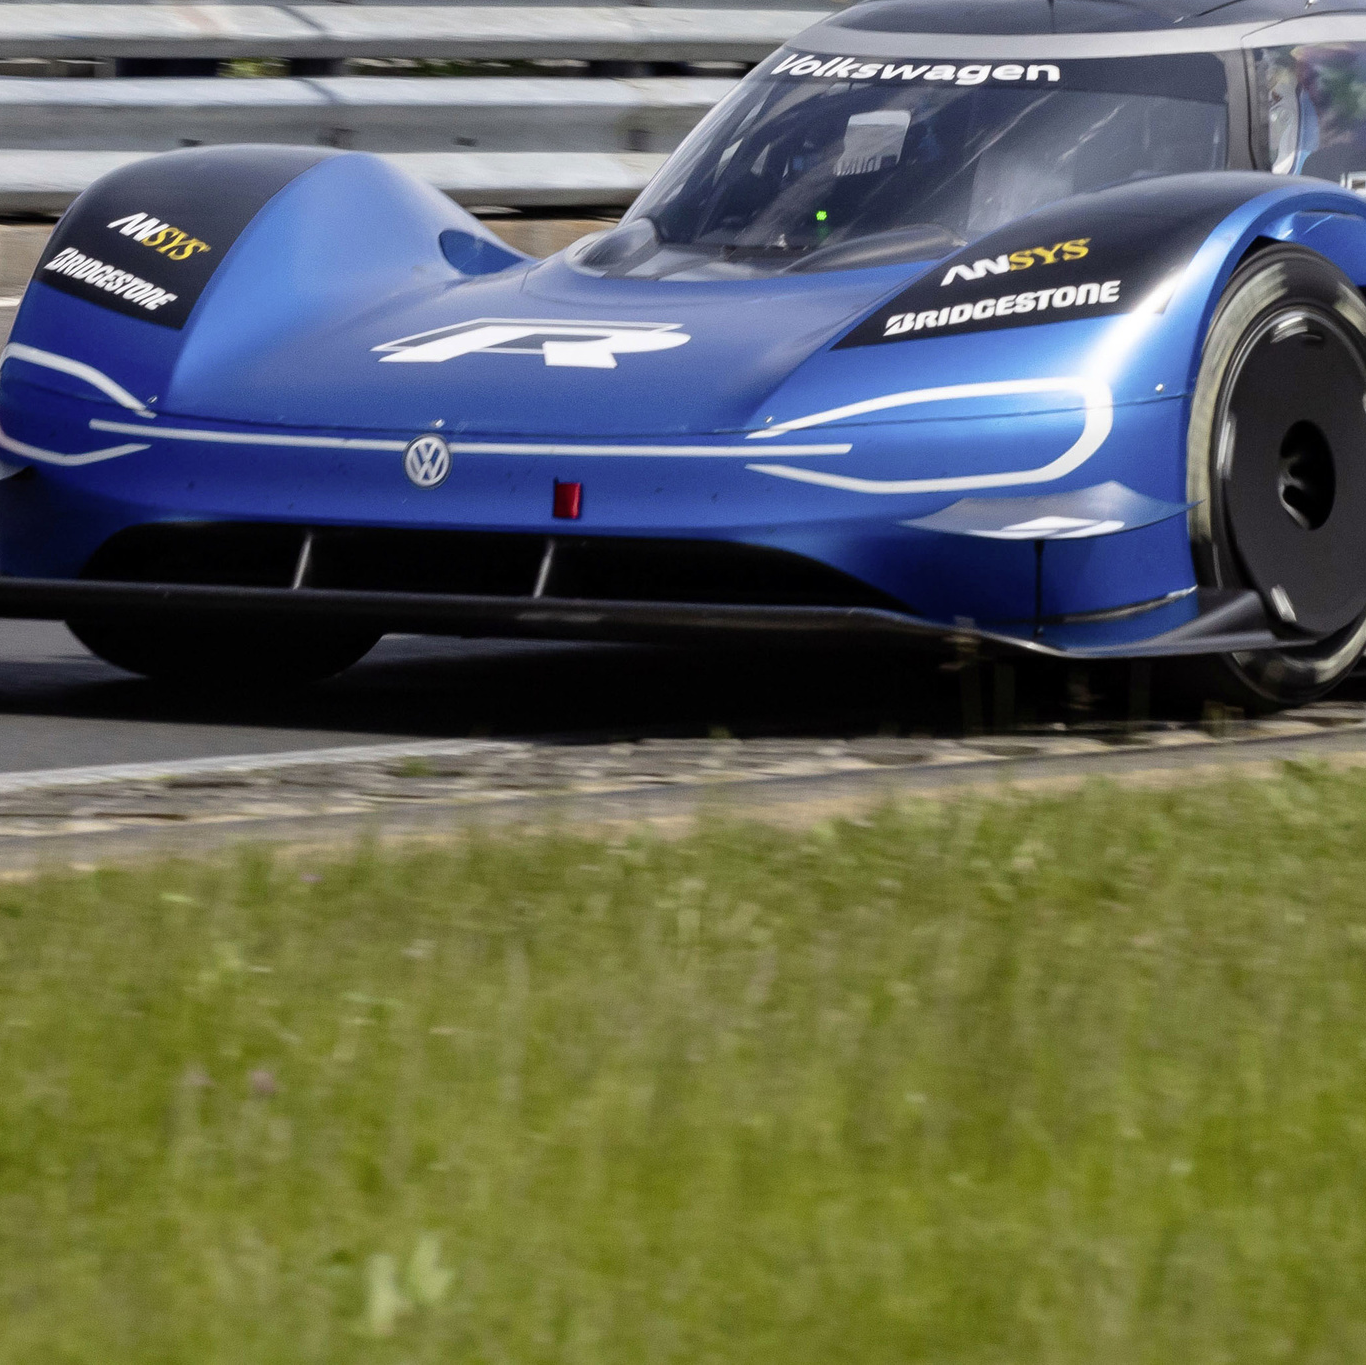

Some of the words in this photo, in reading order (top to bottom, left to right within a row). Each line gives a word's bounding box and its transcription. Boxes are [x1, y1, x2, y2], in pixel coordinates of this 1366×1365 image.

[770, 53, 1061, 86] Volkswagen
[106, 211, 212, 261] ANSYS
[43, 246, 179, 311] BRIDGESTONE
[940, 237, 1092, 287] ANSYS
[883, 280, 1122, 336] BRIDGESTONE
